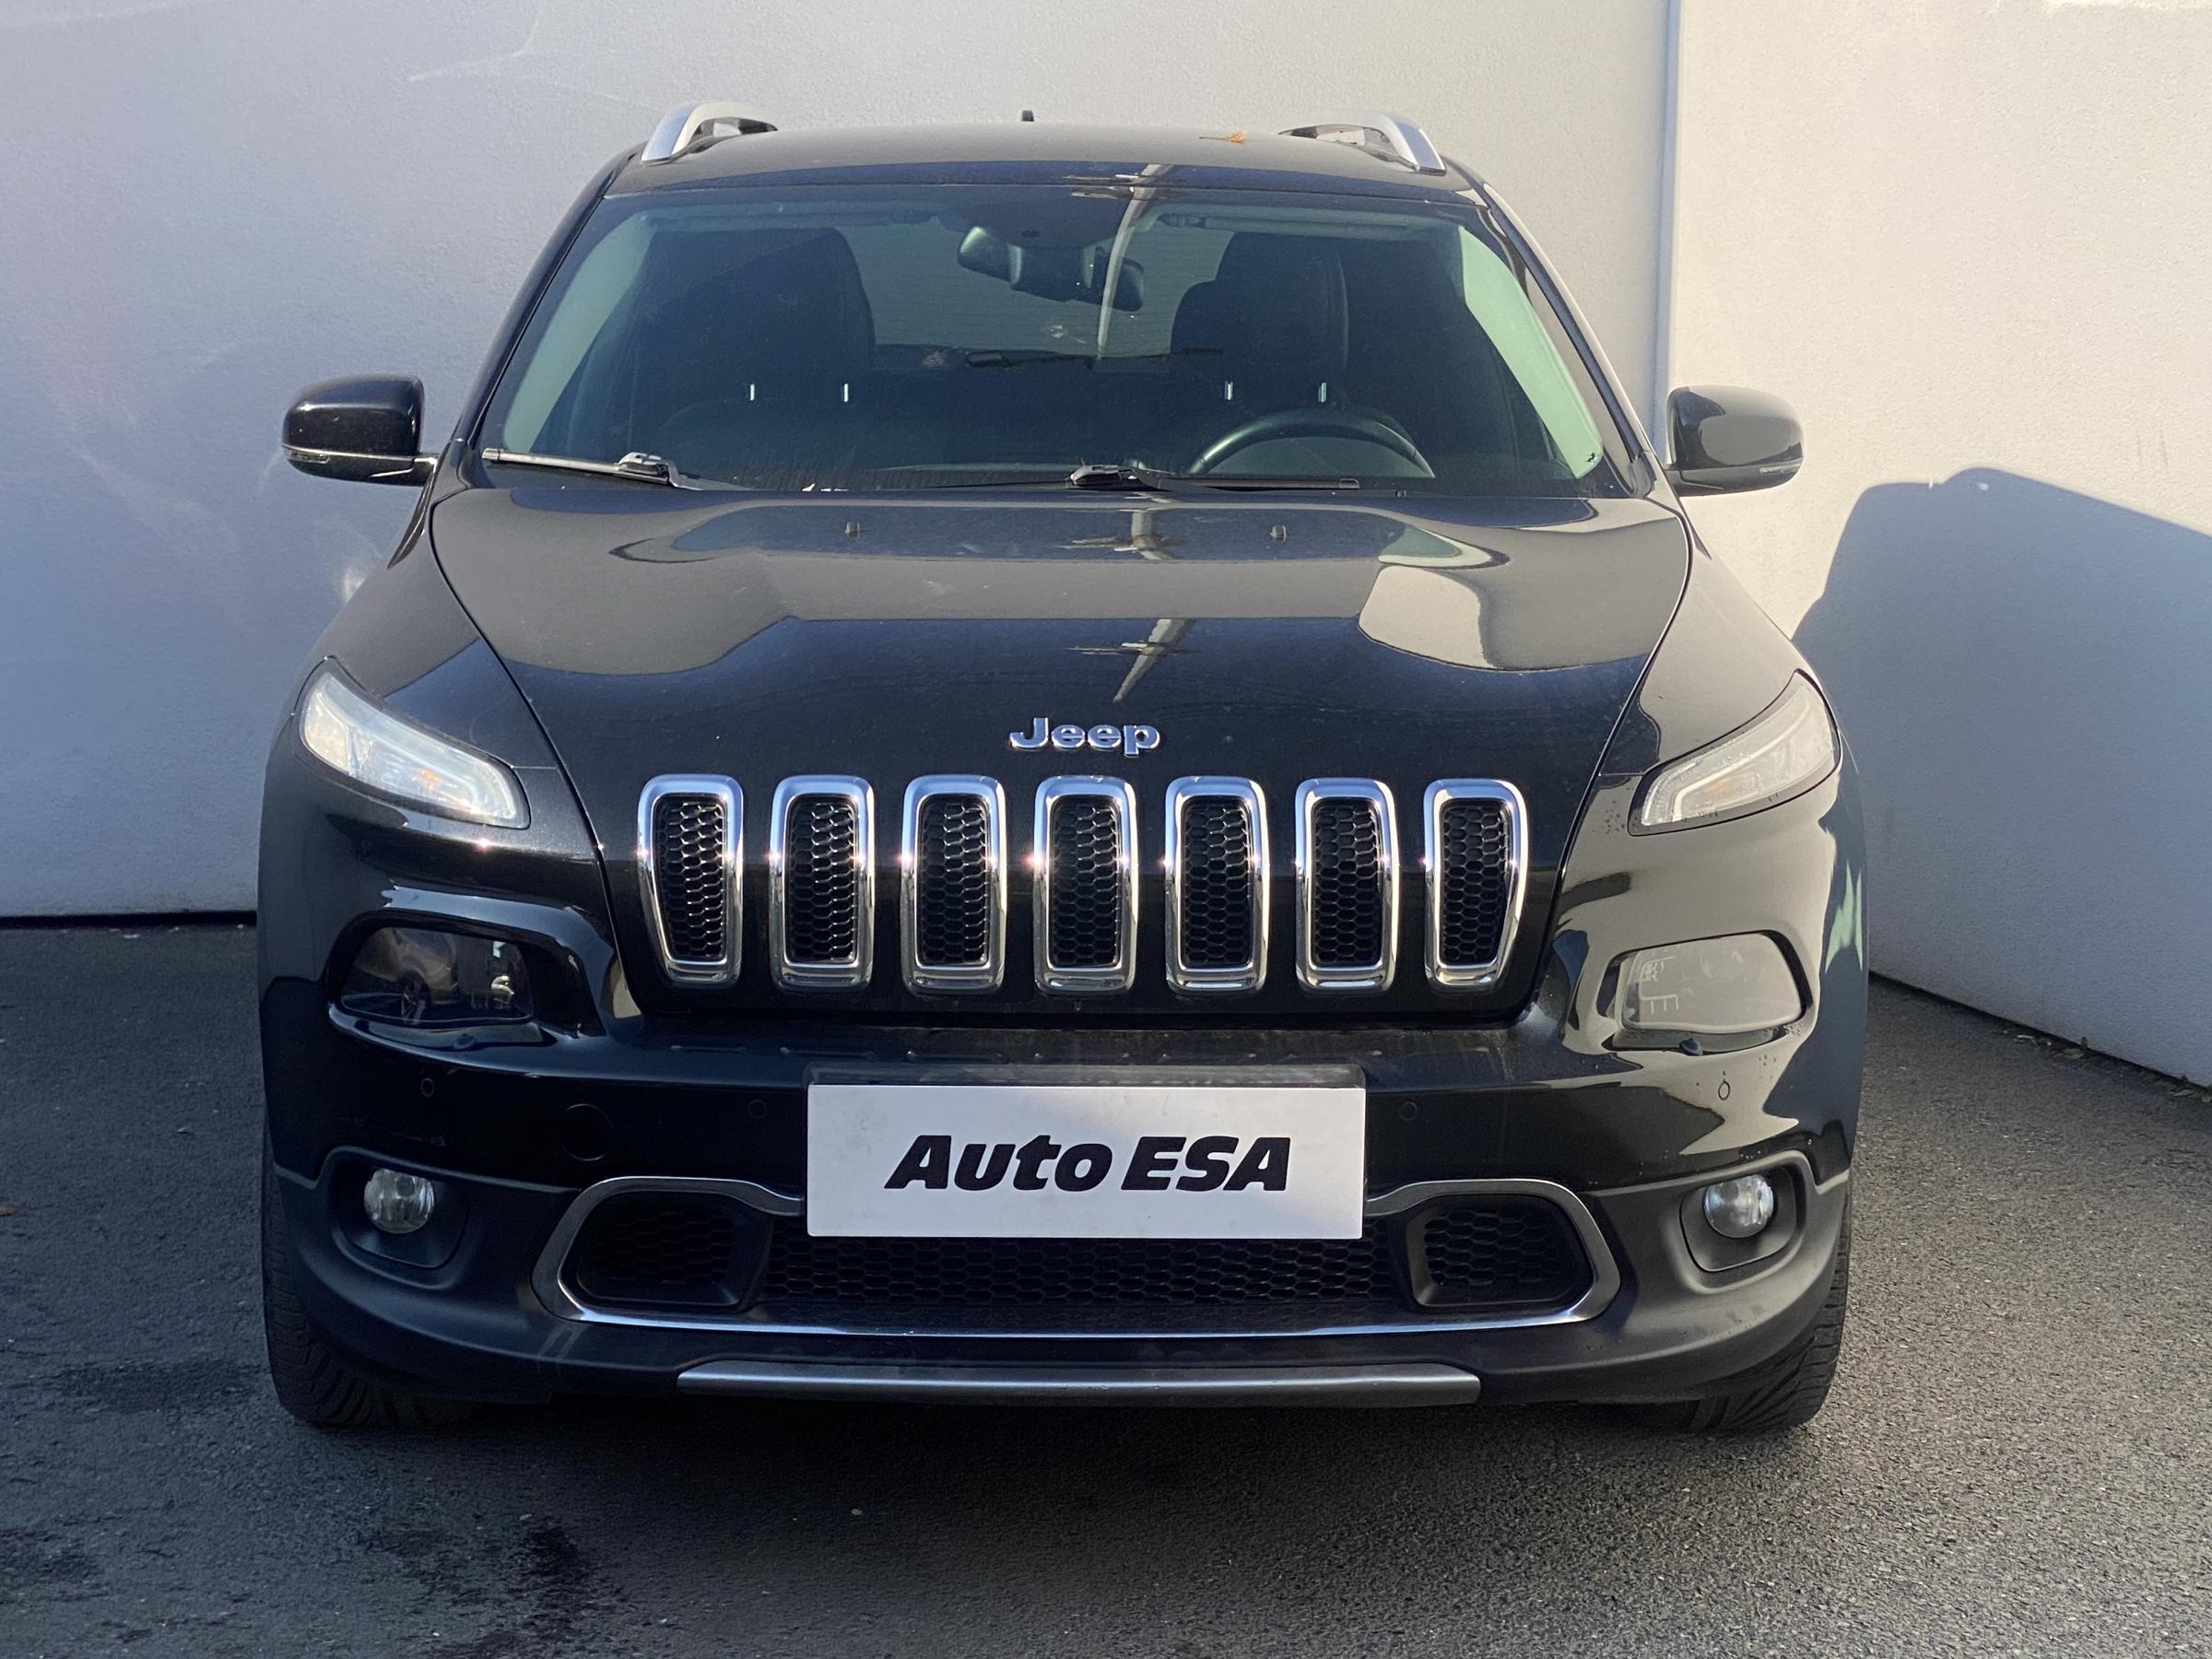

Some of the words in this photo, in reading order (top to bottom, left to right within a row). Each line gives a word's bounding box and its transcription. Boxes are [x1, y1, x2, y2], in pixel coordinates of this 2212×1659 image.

[1009, 717, 1160, 758] Jeep
[884, 1135, 1112, 1192] Auto
[1121, 1135, 1291, 1192] ESA
